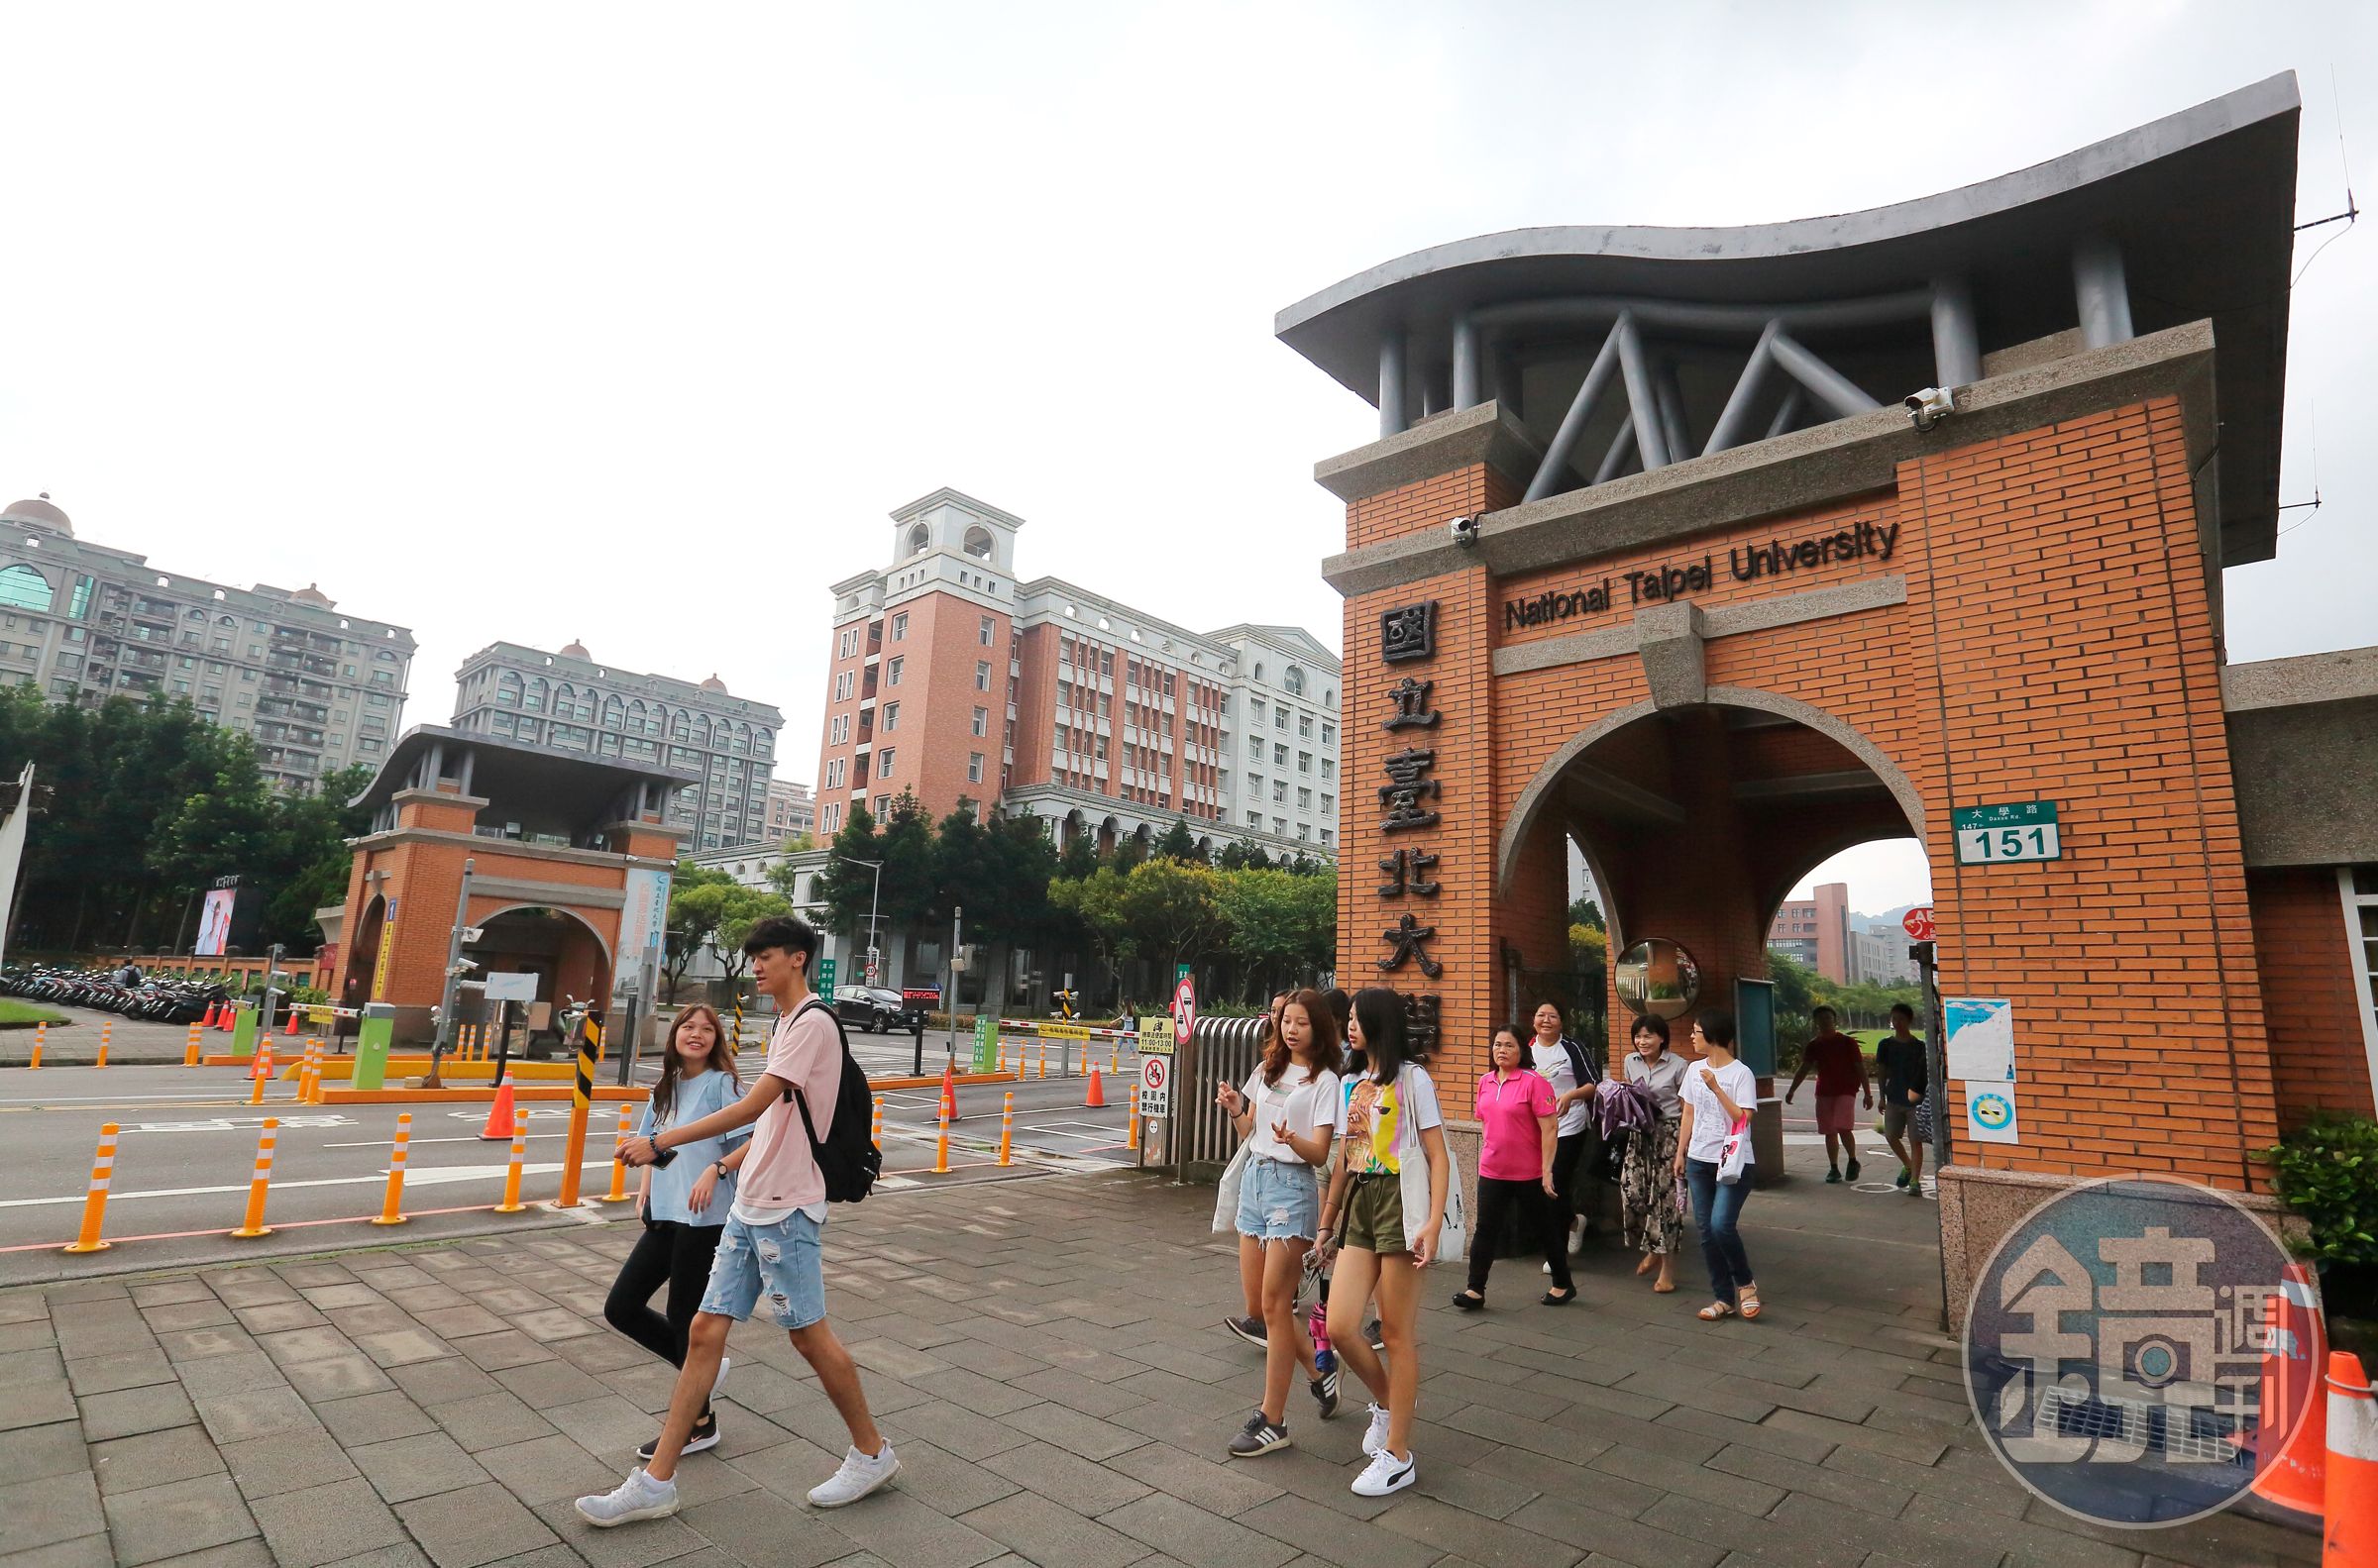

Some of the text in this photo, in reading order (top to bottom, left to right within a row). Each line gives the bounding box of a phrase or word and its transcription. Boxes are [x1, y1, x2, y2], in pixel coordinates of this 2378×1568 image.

[1505, 520, 1900, 633] National Taipei University
[1972, 804, 2038, 819] 大學路
[1976, 827, 2045, 859] 151
[389, 903, 394, 920] 1
[1141, 1091, 1166, 1101] 校園內
[1141, 1101, 1166, 1113] 禁行機車
